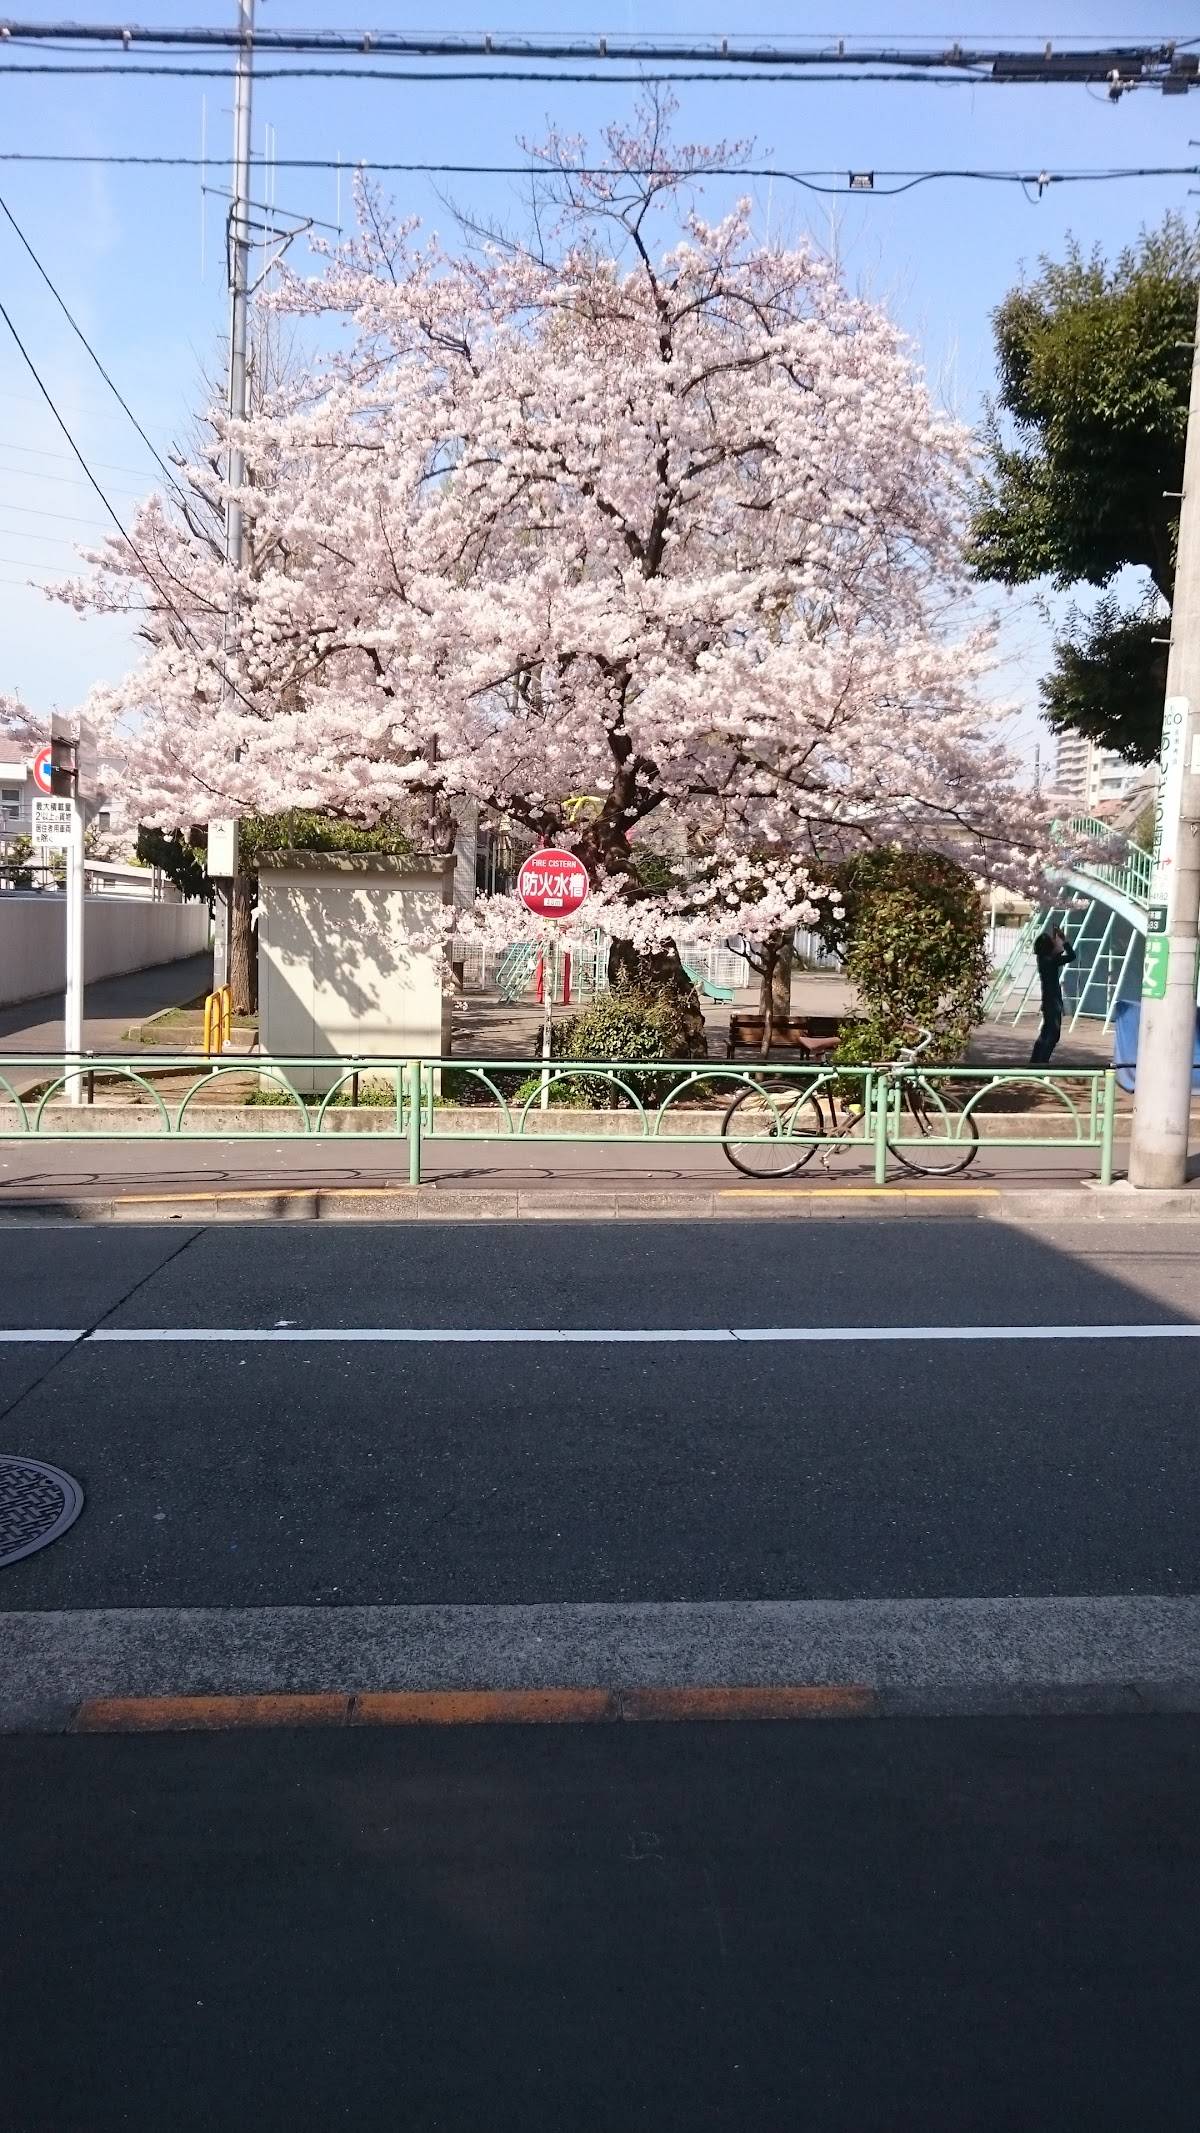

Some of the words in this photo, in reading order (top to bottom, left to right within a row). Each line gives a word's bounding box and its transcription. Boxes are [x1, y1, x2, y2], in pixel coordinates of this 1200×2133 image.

[36, 802, 71, 811] 最大積載量
[36, 824, 71, 833] 居住者用車両
[532, 859, 546, 867] FIRE
[549, 860, 576, 868] CISTERN
[523, 871, 585, 897] 防火水槽
